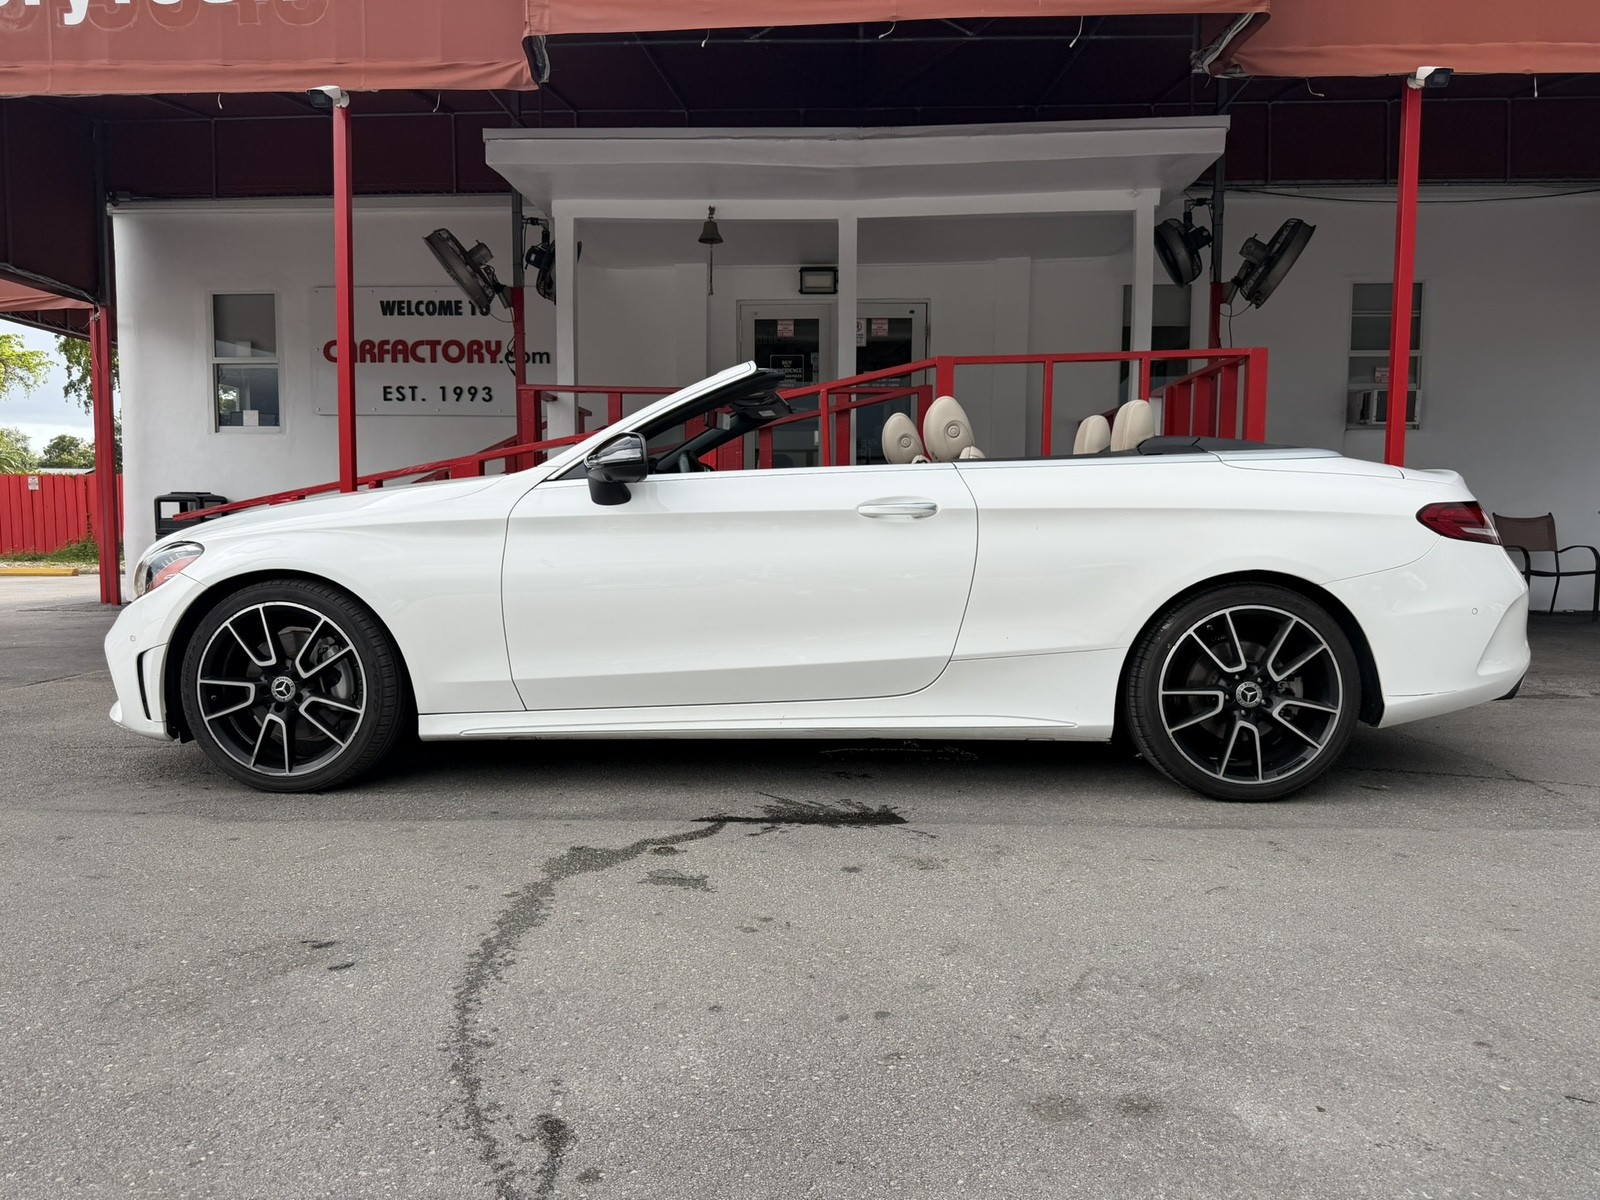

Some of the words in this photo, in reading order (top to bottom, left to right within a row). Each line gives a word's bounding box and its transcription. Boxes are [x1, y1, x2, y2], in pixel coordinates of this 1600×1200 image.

[380, 300, 463, 316] WELCOME
[469, 300, 491, 316] TO
[322, 339, 551, 364] CRFACTORY.cm
[382, 386, 427, 402] EST.
[439, 386, 493, 402] 1993
